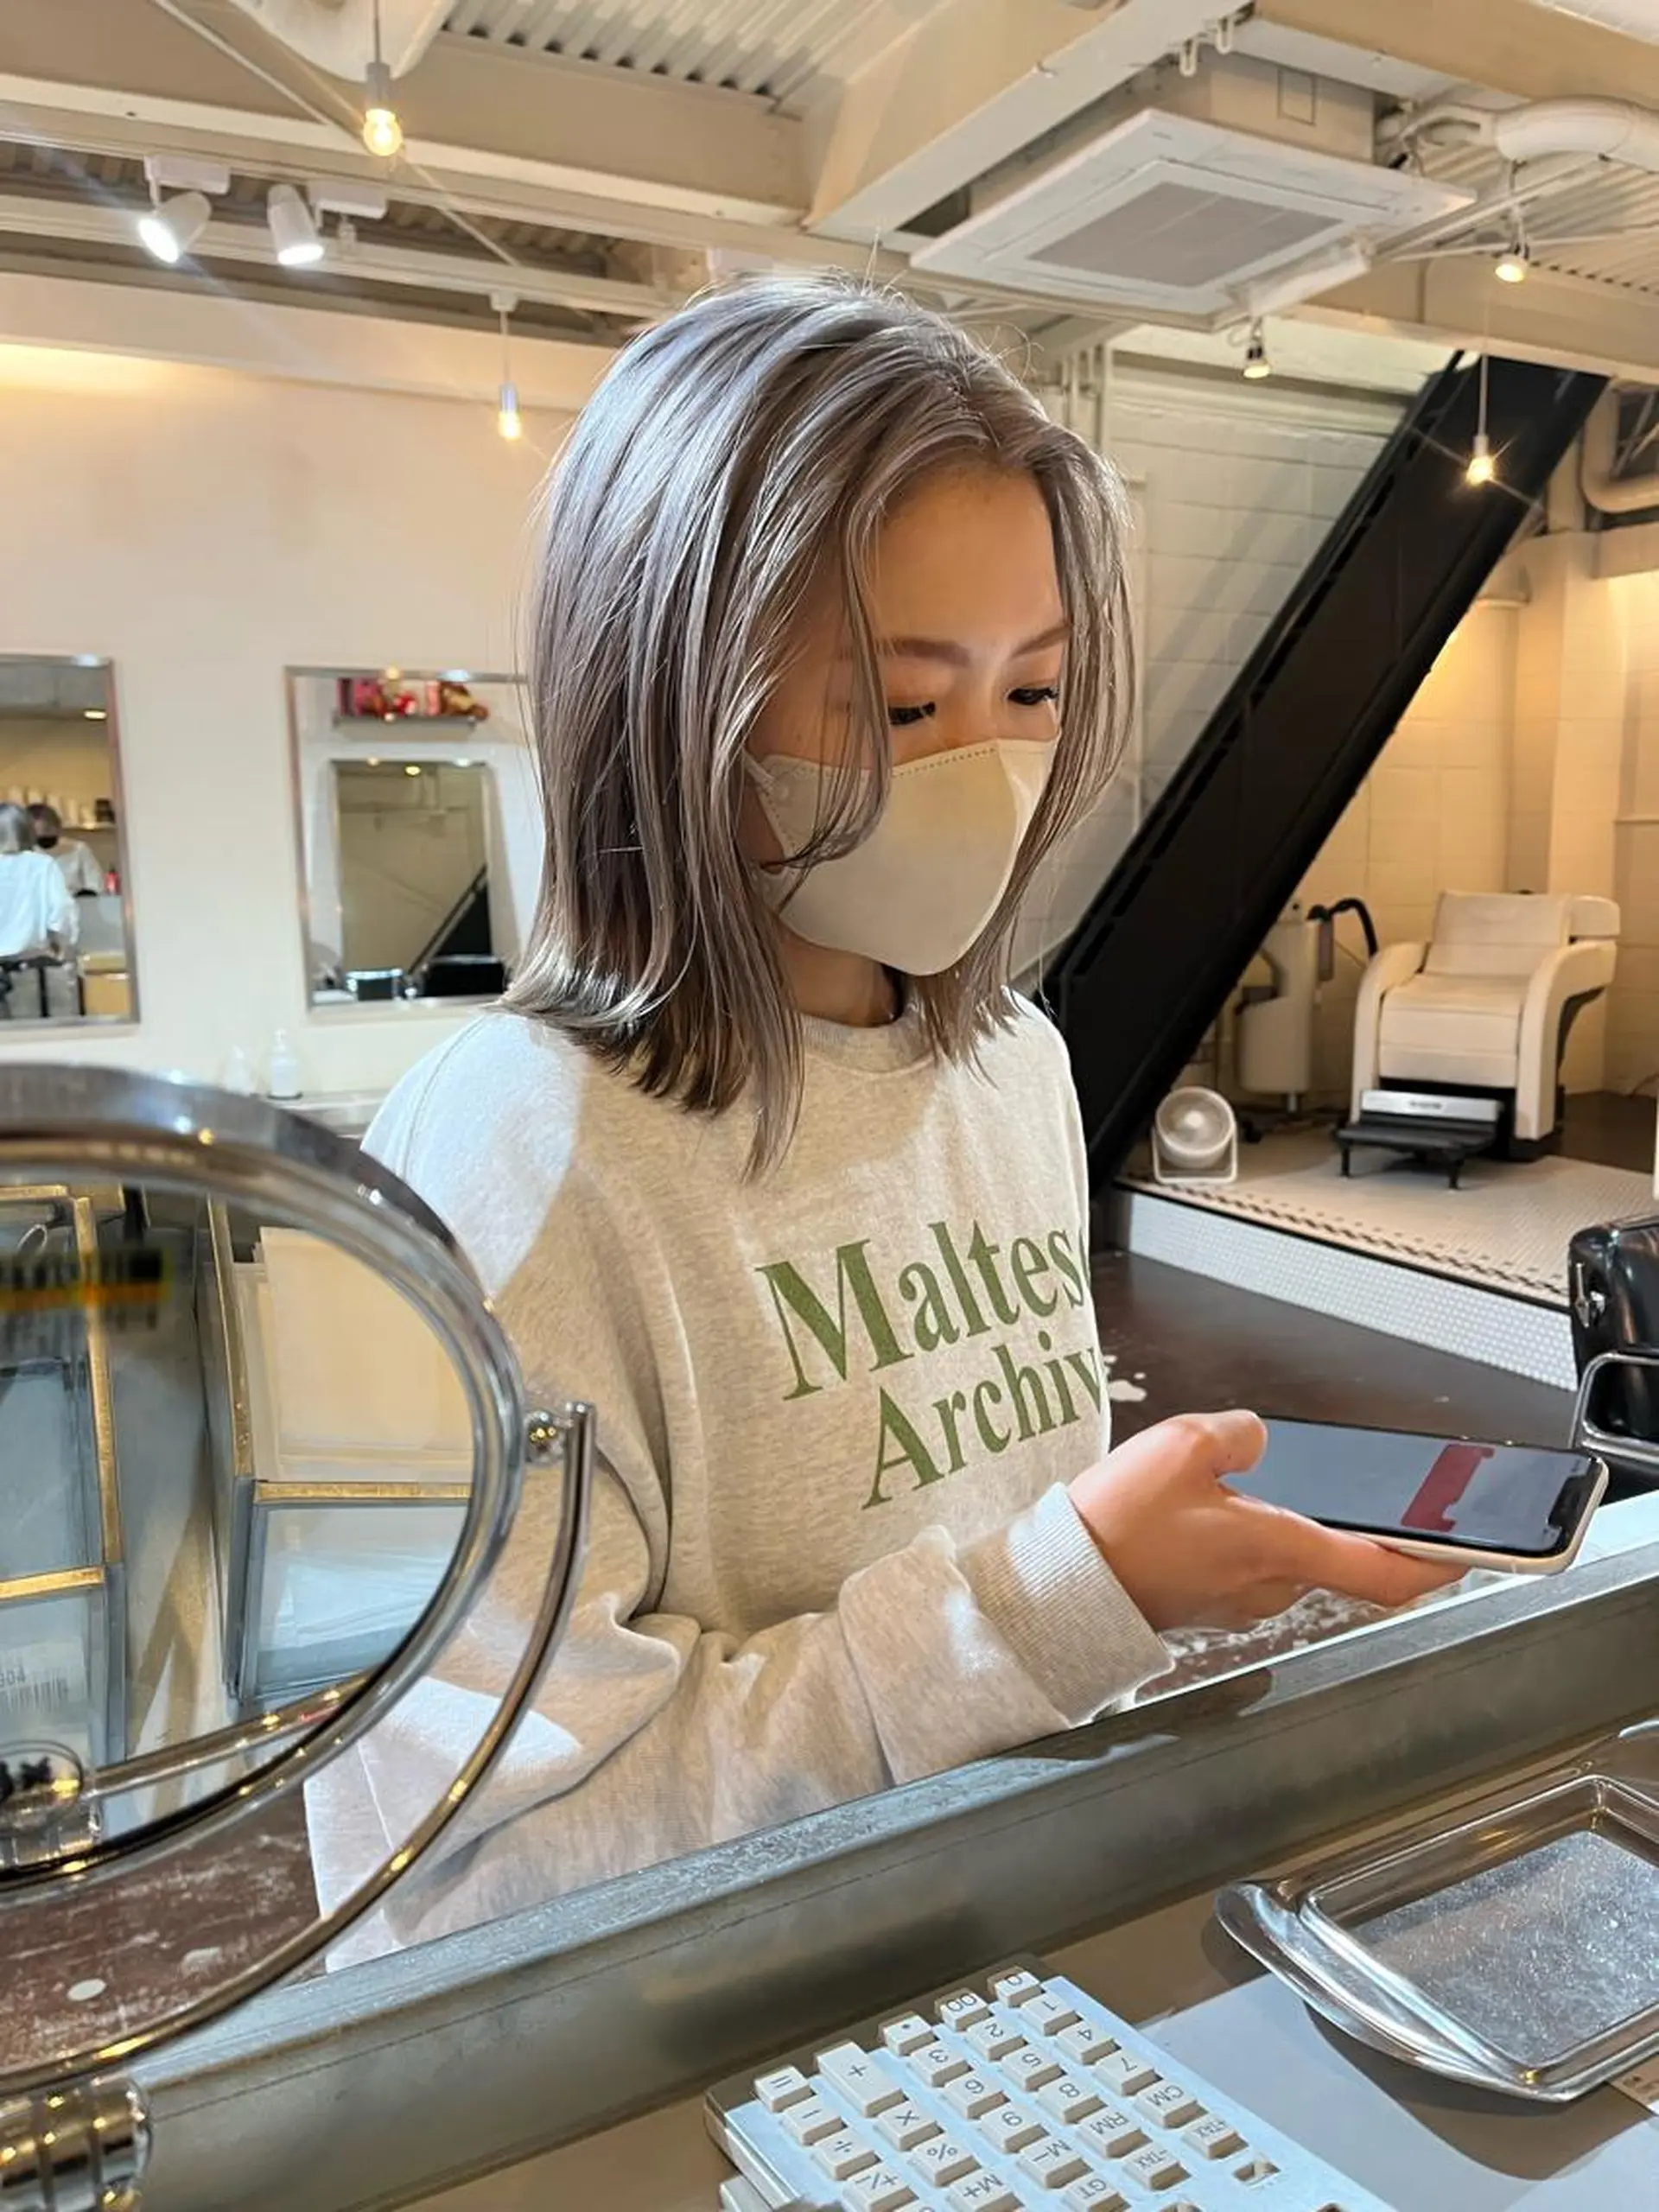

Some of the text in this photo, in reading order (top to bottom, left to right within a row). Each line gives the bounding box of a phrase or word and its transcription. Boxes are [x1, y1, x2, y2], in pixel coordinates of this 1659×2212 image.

[755, 1219, 1089, 1400] Maltes
[1042, 2000, 1058, 2011] 1
[984, 2023, 1004, 2037] 2
[1077, 2028, 1093, 2042] 4
[928, 2049, 949, 2063] 3
[1021, 2052, 1042, 2068] 5
[1121, 2056, 1138, 2073] 7
[1058, 2082, 1080, 2098] 8
[1146, 2084, 1185, 2107] CM
[1089, 2112, 1130, 2135] RM
[1079, 2177, 1108, 2200] GT
